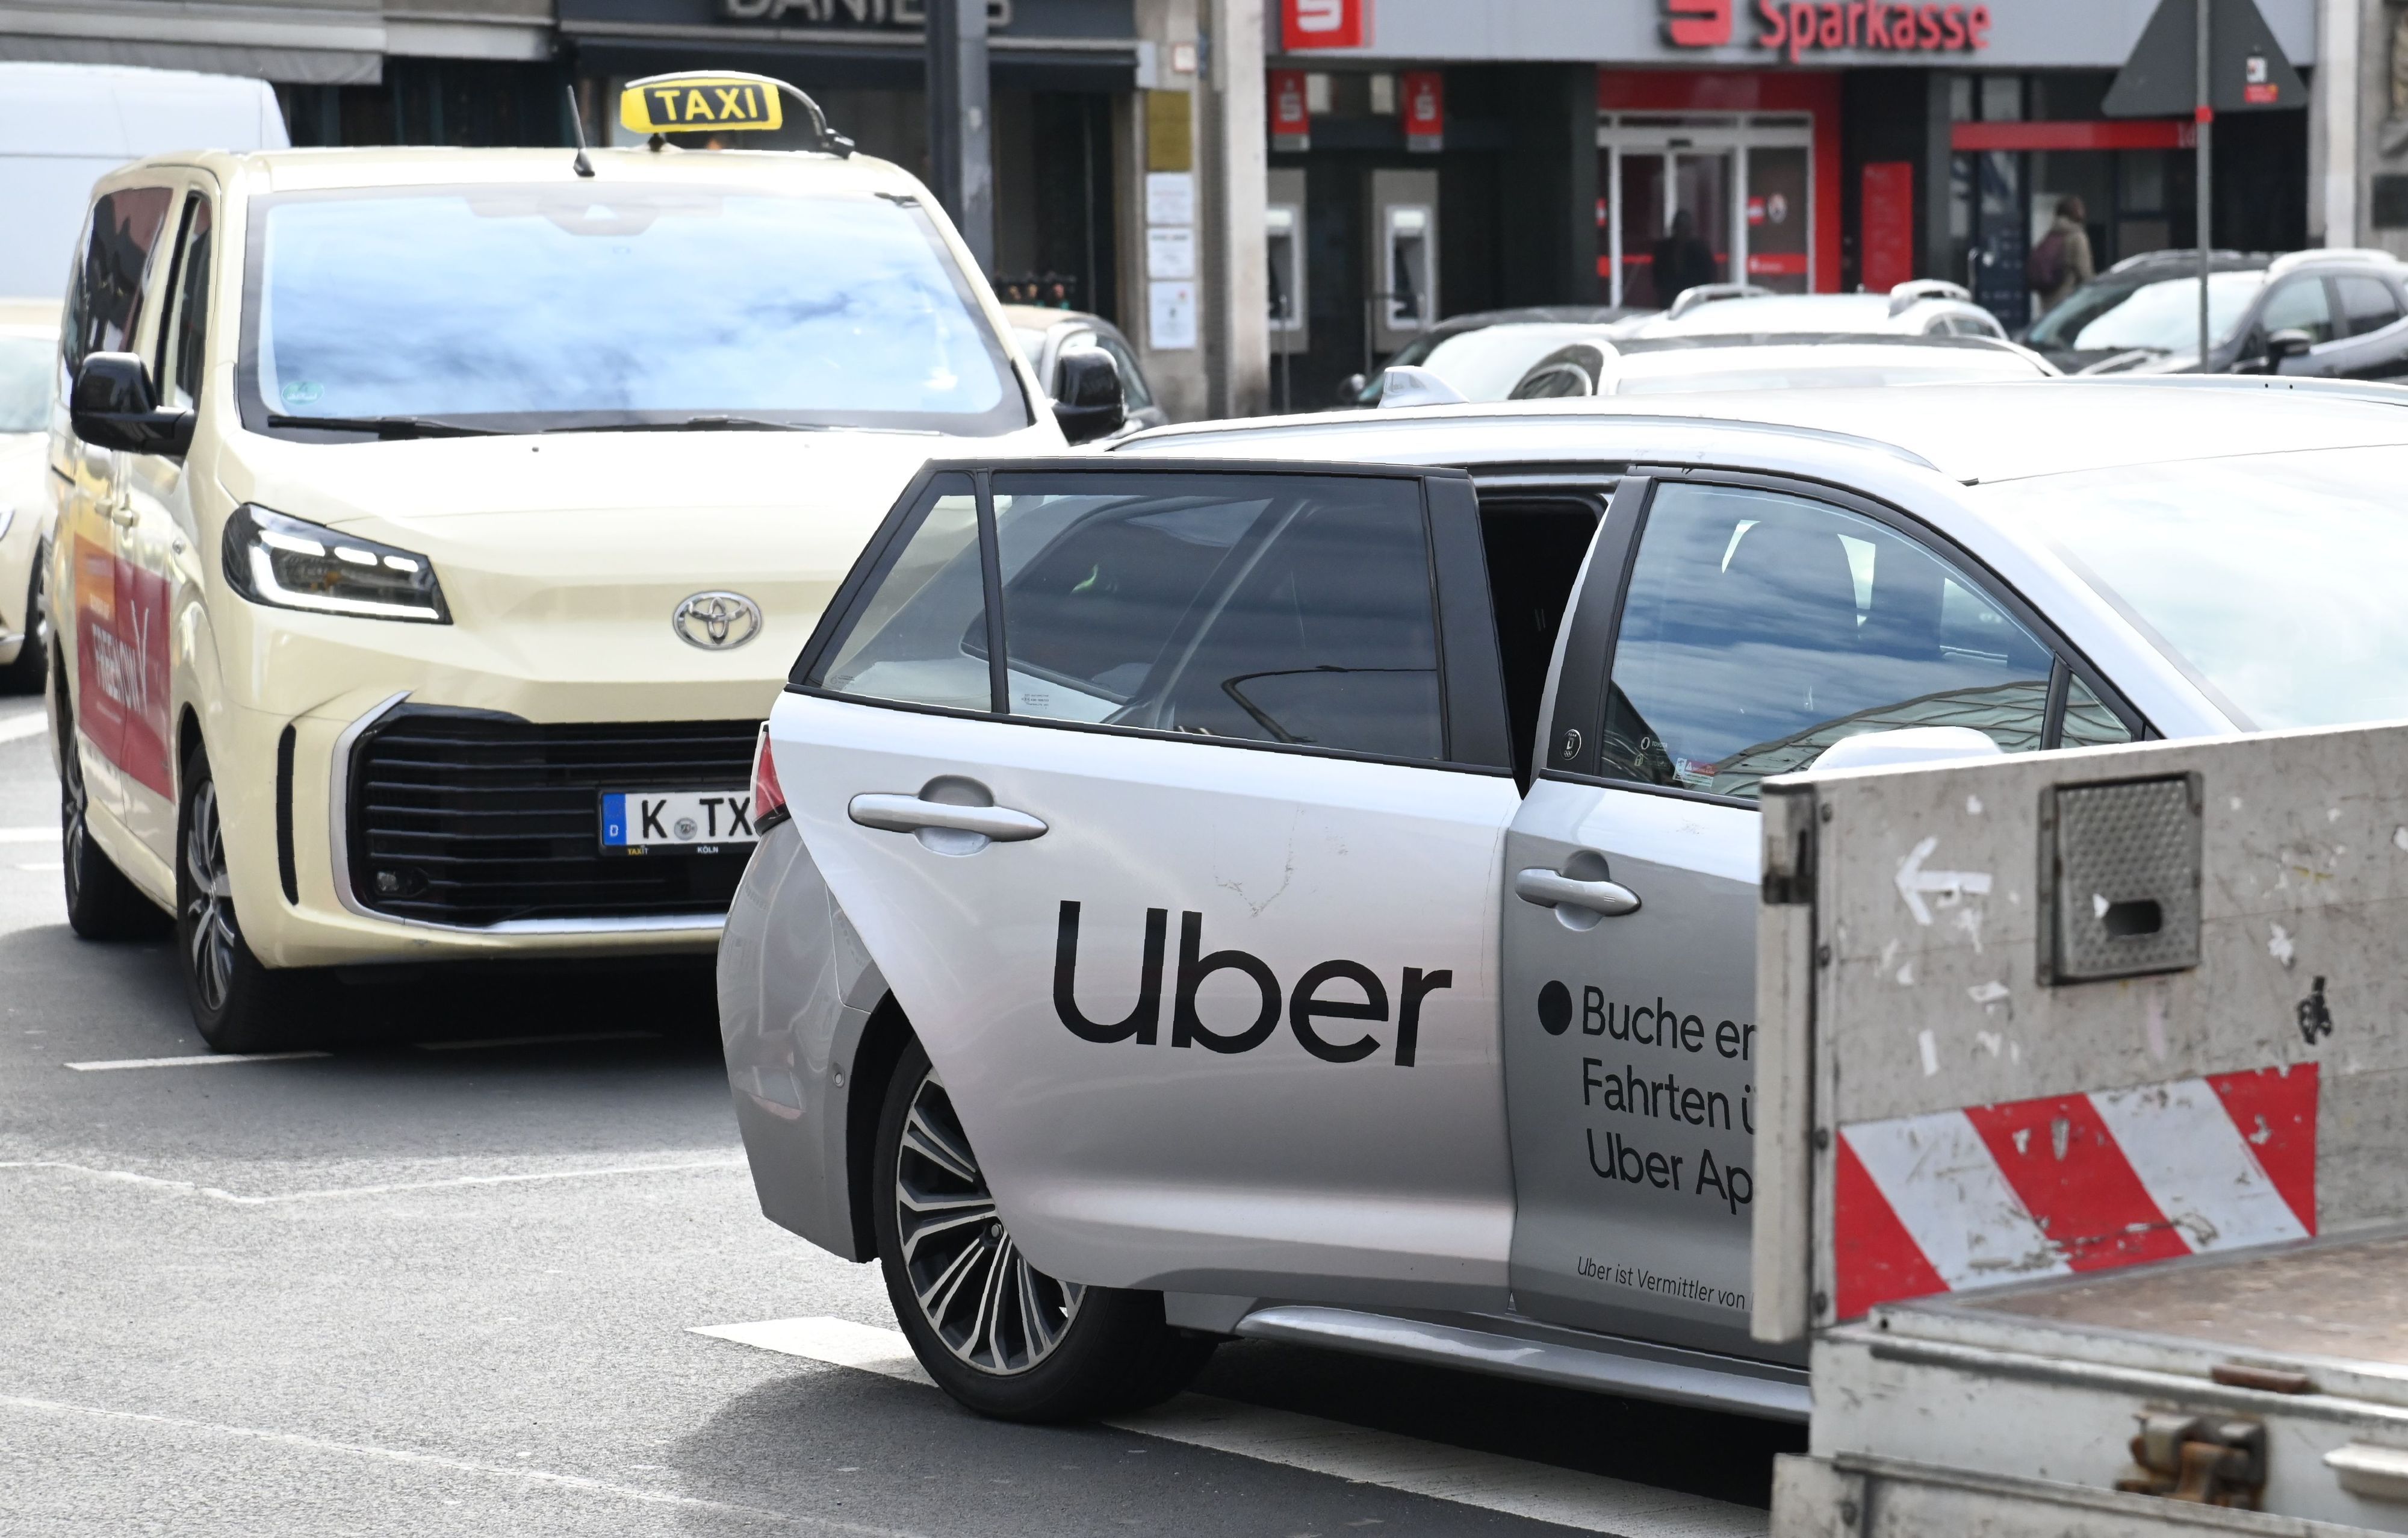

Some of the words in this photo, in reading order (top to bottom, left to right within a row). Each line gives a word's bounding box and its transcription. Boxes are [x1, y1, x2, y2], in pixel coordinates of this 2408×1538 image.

[1758, 0, 1990, 63] Sparkasse
[654, 87, 758, 121] TAXI
[610, 824, 618, 837] D
[642, 799, 668, 839] K
[699, 797, 753, 836] TX
[697, 845, 719, 854] KÖLN
[1054, 900, 1453, 1068] Uber
[1583, 985, 1704, 1053] Buche
[1583, 1057, 1731, 1130] Fahrten
[1586, 1128, 1683, 1191] Uber
[1578, 1256, 1612, 1281] Uber
[1616, 1264, 1633, 1286] ist
[1637, 1268, 1714, 1303] Vermittler
[1718, 1289, 1745, 1310] von
